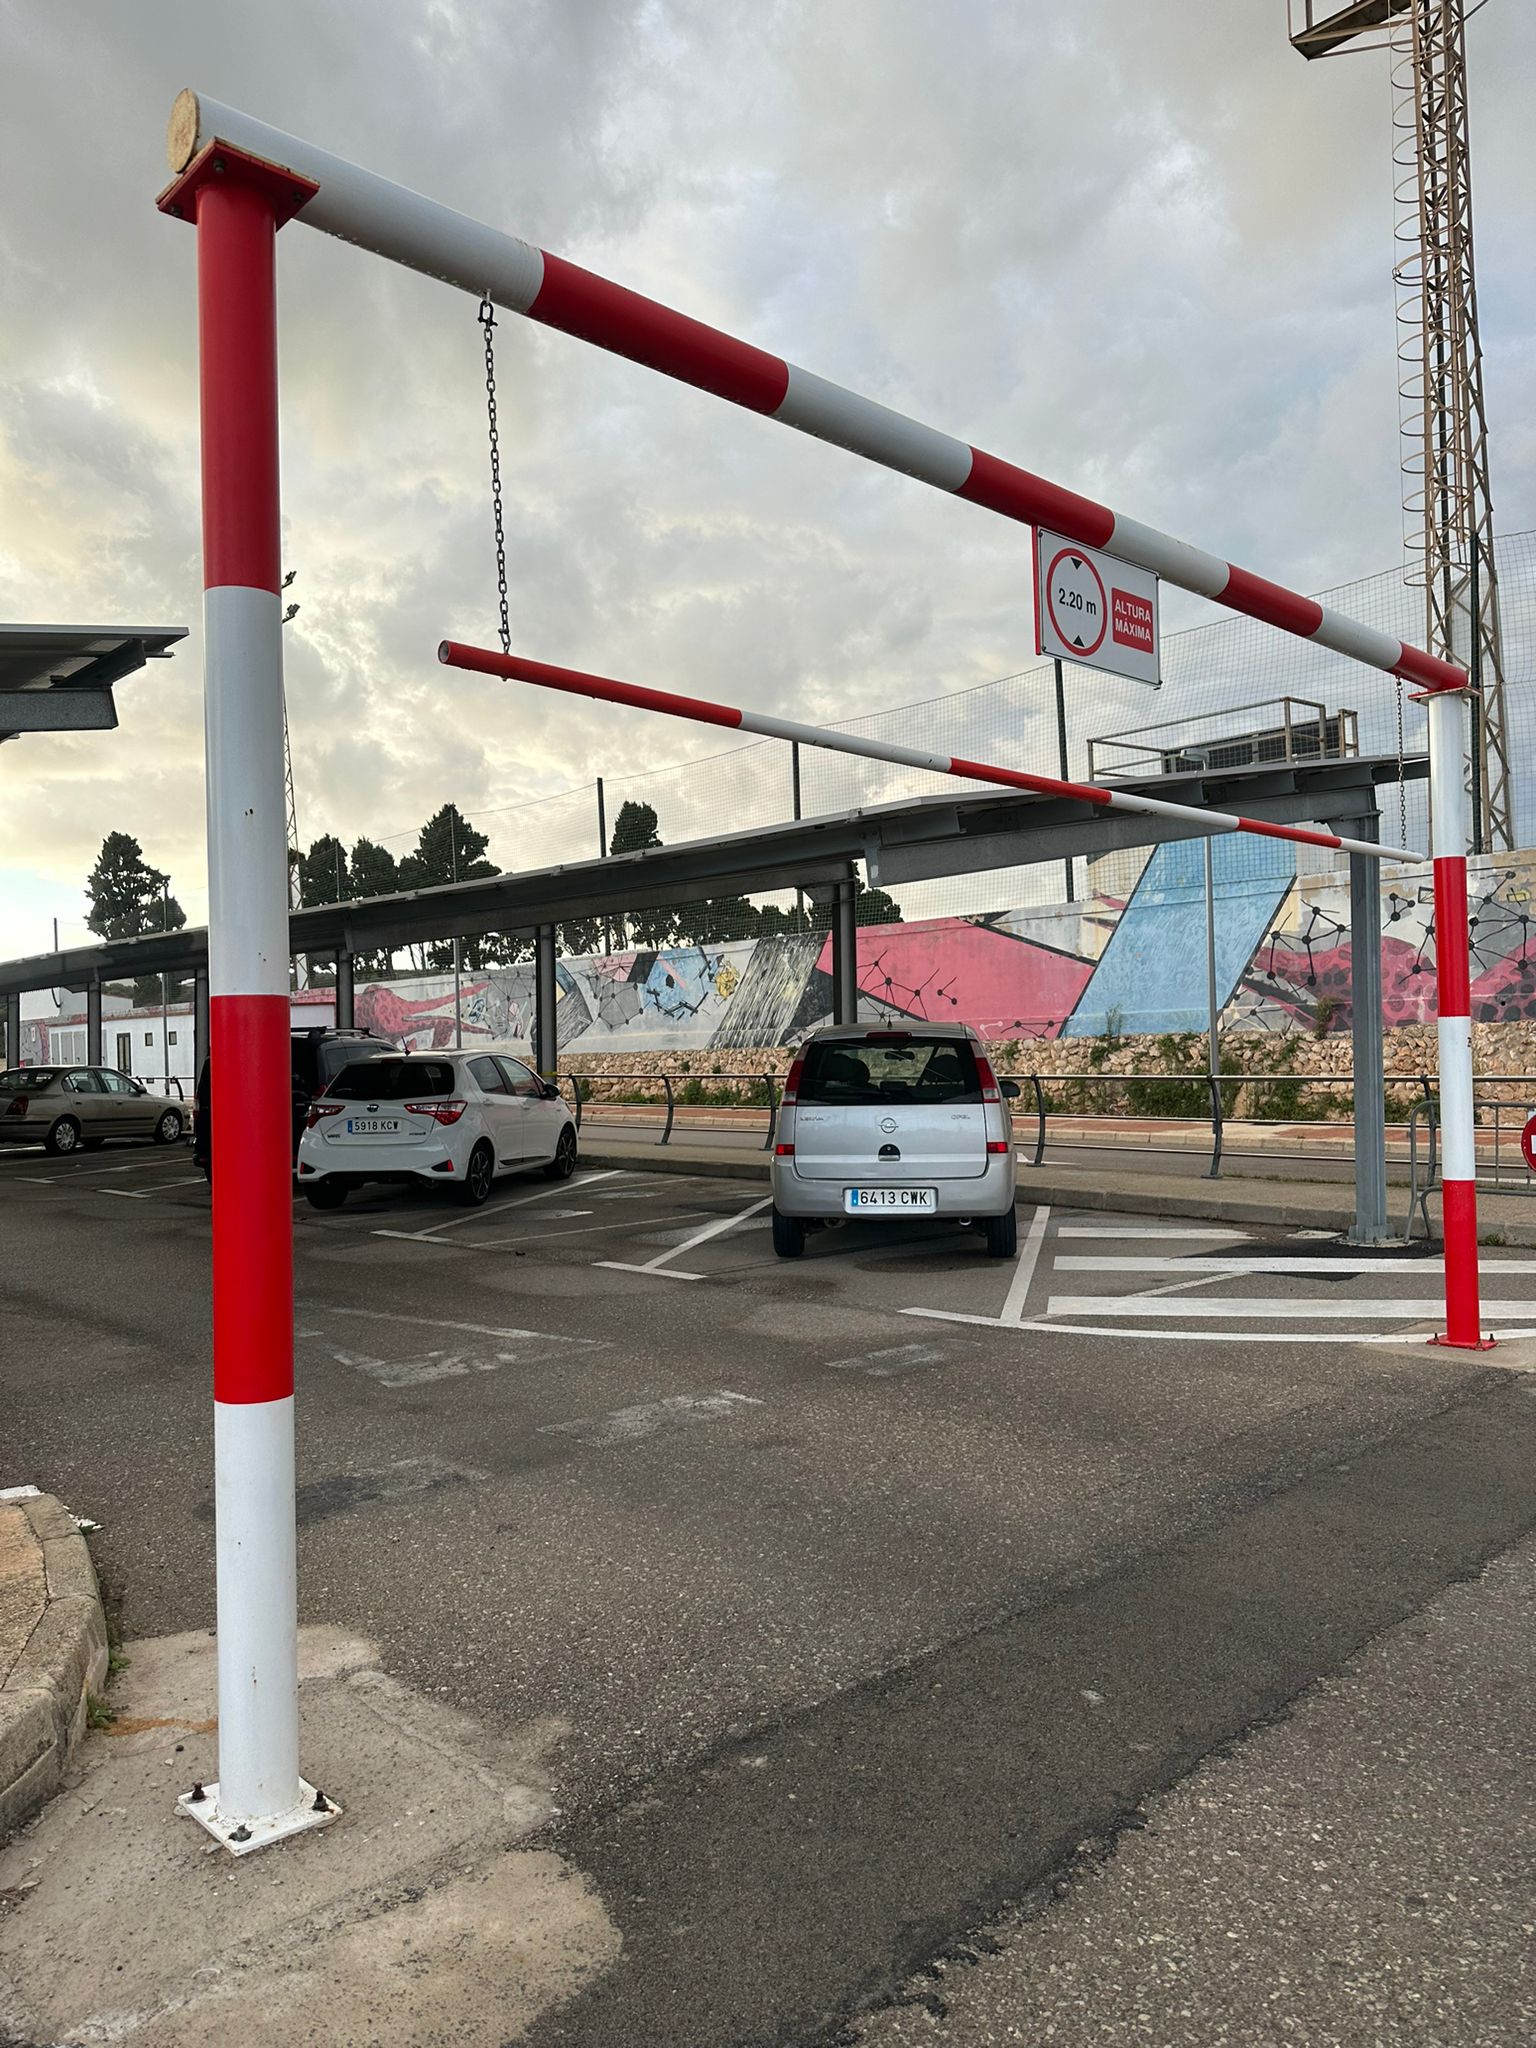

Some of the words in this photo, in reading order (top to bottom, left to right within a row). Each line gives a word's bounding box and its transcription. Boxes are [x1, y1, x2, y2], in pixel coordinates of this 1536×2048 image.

[1059, 587, 1083, 611] 2.20
[1086, 601, 1097, 615] m
[1114, 599, 1152, 624] ALTURA
[354, 1121, 378, 1131] 5918
[380, 1120, 399, 1130] KCW
[860, 1191, 896, 1205] 6413
[900, 1191, 928, 1205] CWK
